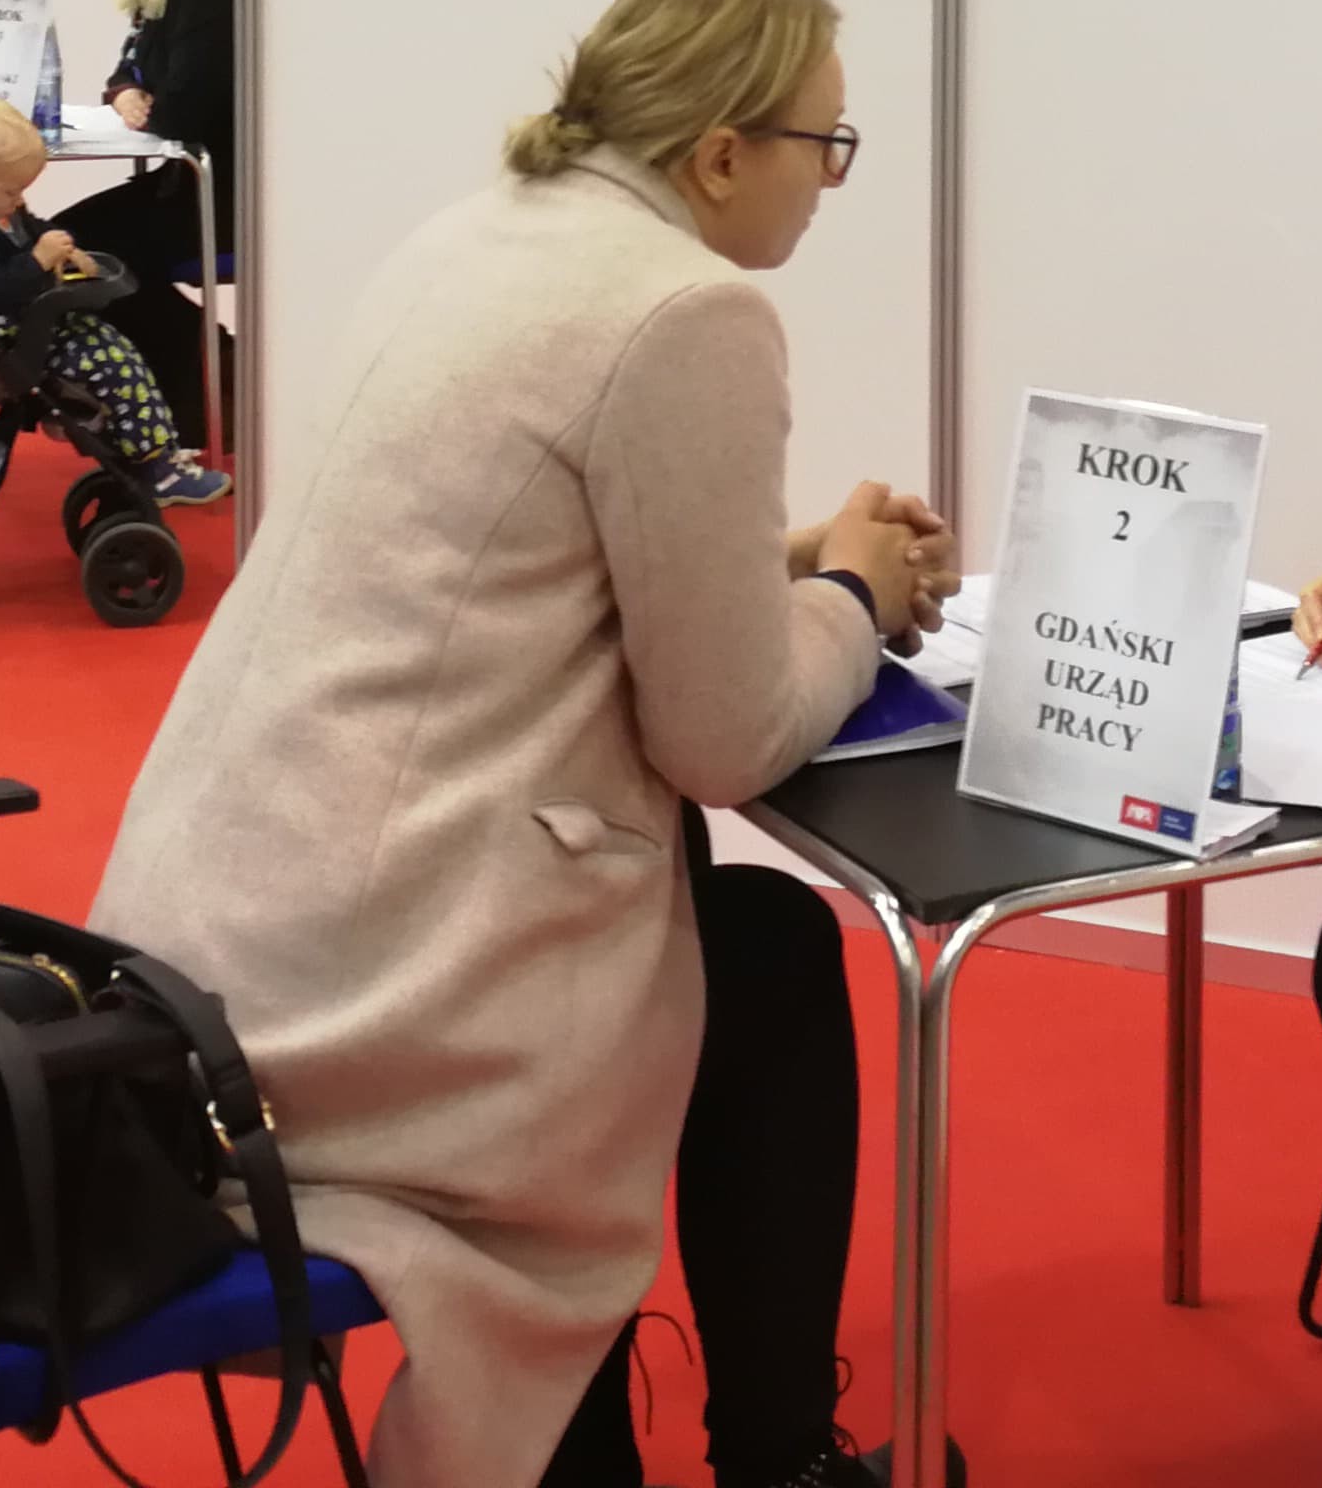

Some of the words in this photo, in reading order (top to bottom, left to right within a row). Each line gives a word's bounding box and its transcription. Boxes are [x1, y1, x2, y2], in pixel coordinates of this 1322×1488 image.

[1077, 442, 1190, 494] KROK
[1111, 510, 1131, 542] 2
[1034, 611, 1177, 667] GDAŃSKI
[1044, 658, 1150, 711] URZĄD
[1036, 703, 1143, 752] PRACY
